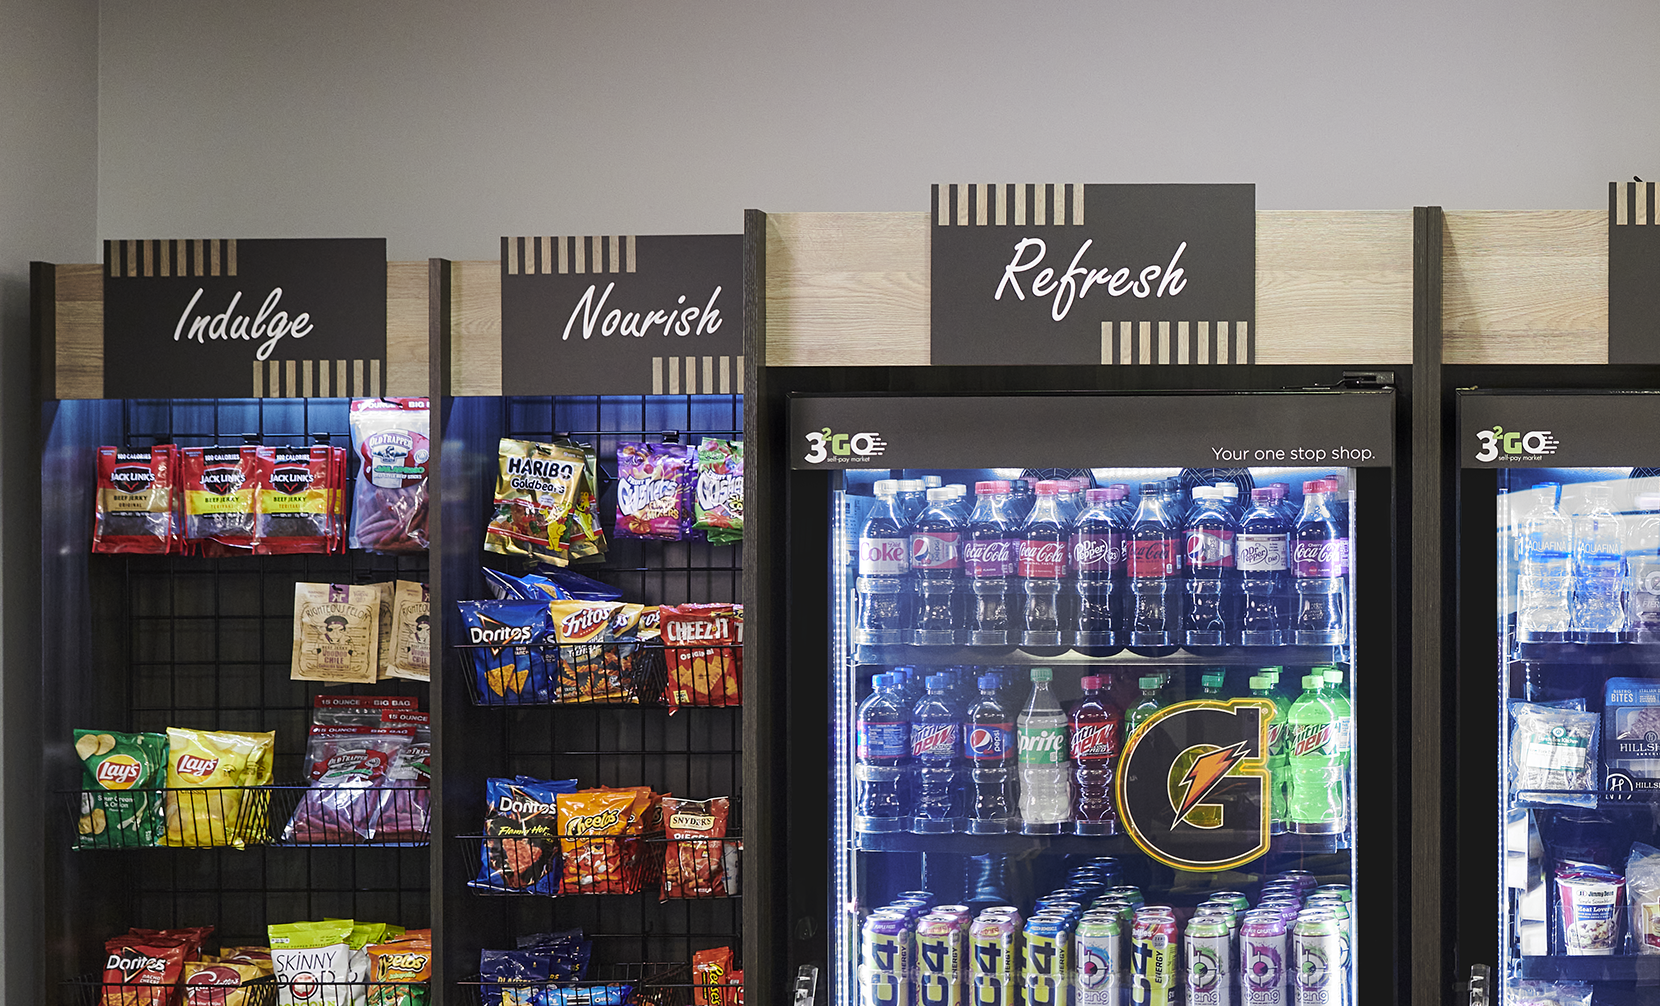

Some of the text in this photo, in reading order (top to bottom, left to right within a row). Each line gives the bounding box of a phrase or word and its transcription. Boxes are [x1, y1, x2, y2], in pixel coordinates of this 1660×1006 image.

[995, 237, 1187, 322] Refresh
[563, 282, 723, 342] Nourish
[174, 287, 313, 362] Indulge
[1212, 446, 1376, 464] Your one stop shop.
[1498, 454, 1542, 463] self-pay market
[111, 472, 132, 482] JACK
[199, 474, 221, 484] JACK
[507, 457, 574, 481] HARIBO
[861, 542, 904, 562] Coke
[964, 542, 1010, 563] Coca-Cola
[1019, 542, 1065, 563] Coca-Cola
[1578, 541, 1619, 554] AQUAFINA
[561, 608, 611, 637] Fritos
[470, 625, 532, 645] Doritos
[99, 763, 140, 784] Lay's
[178, 755, 217, 777] Lay's
[1116, 698, 1276, 871] G
[566, 809, 620, 835] Cheetos
[106, 956, 166, 972] Doritos
[276, 951, 337, 972] SKINNY
[1155, 950, 1164, 984] ENERGY
